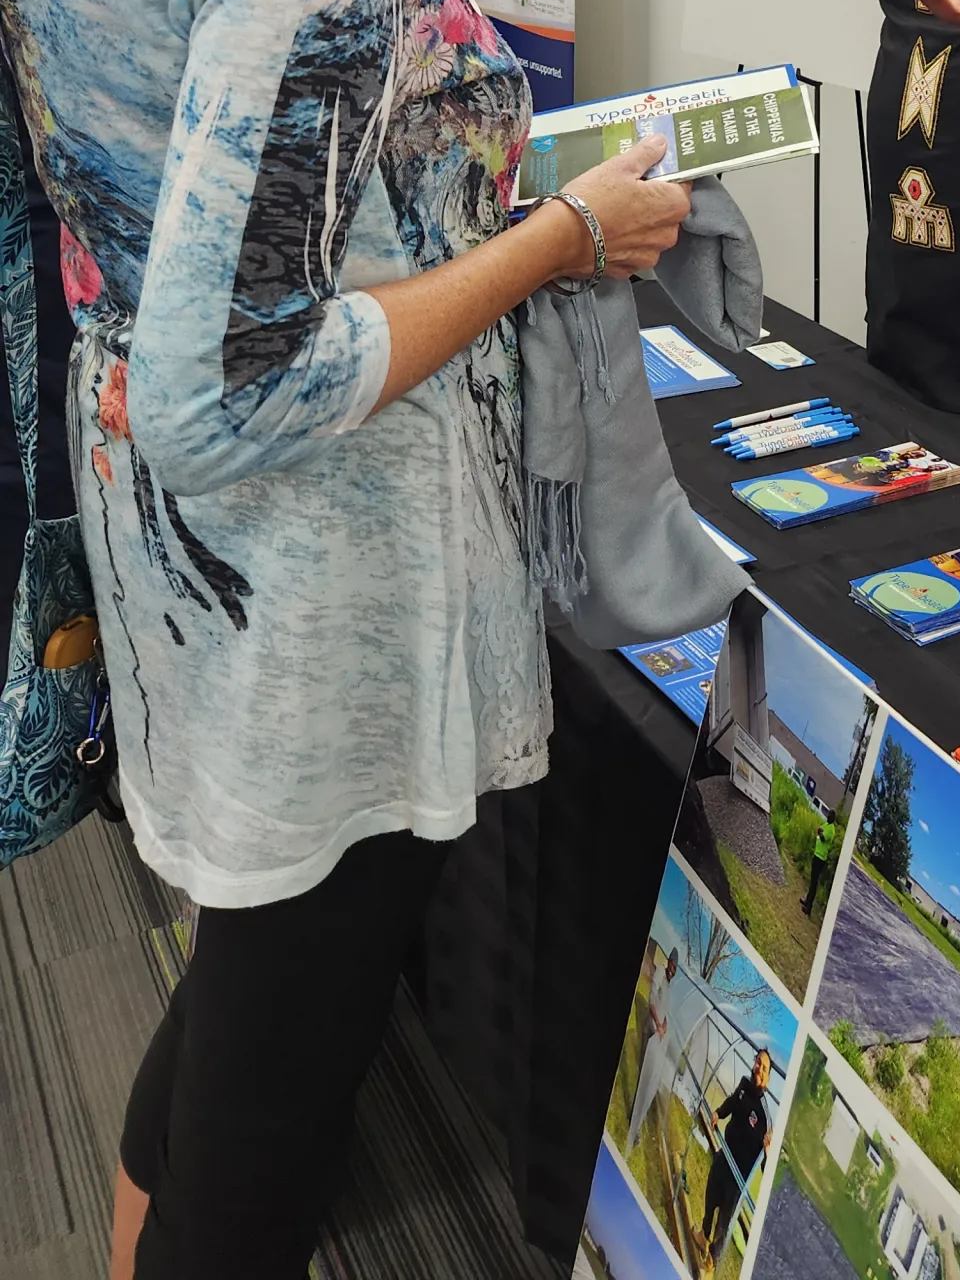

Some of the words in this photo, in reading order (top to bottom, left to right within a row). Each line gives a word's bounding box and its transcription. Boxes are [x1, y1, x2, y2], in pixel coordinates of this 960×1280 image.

[620, 108, 673, 124] IMPACT
[678, 96, 732, 111] REPORT
[743, 106, 758, 118] OF
[763, 93, 785, 143] CHIPPEWAS
[679, 120, 695, 156] NATION
[700, 120, 717, 144] FIRST
[721, 108, 739, 145] THAMES
[745, 119, 761, 137] THE
